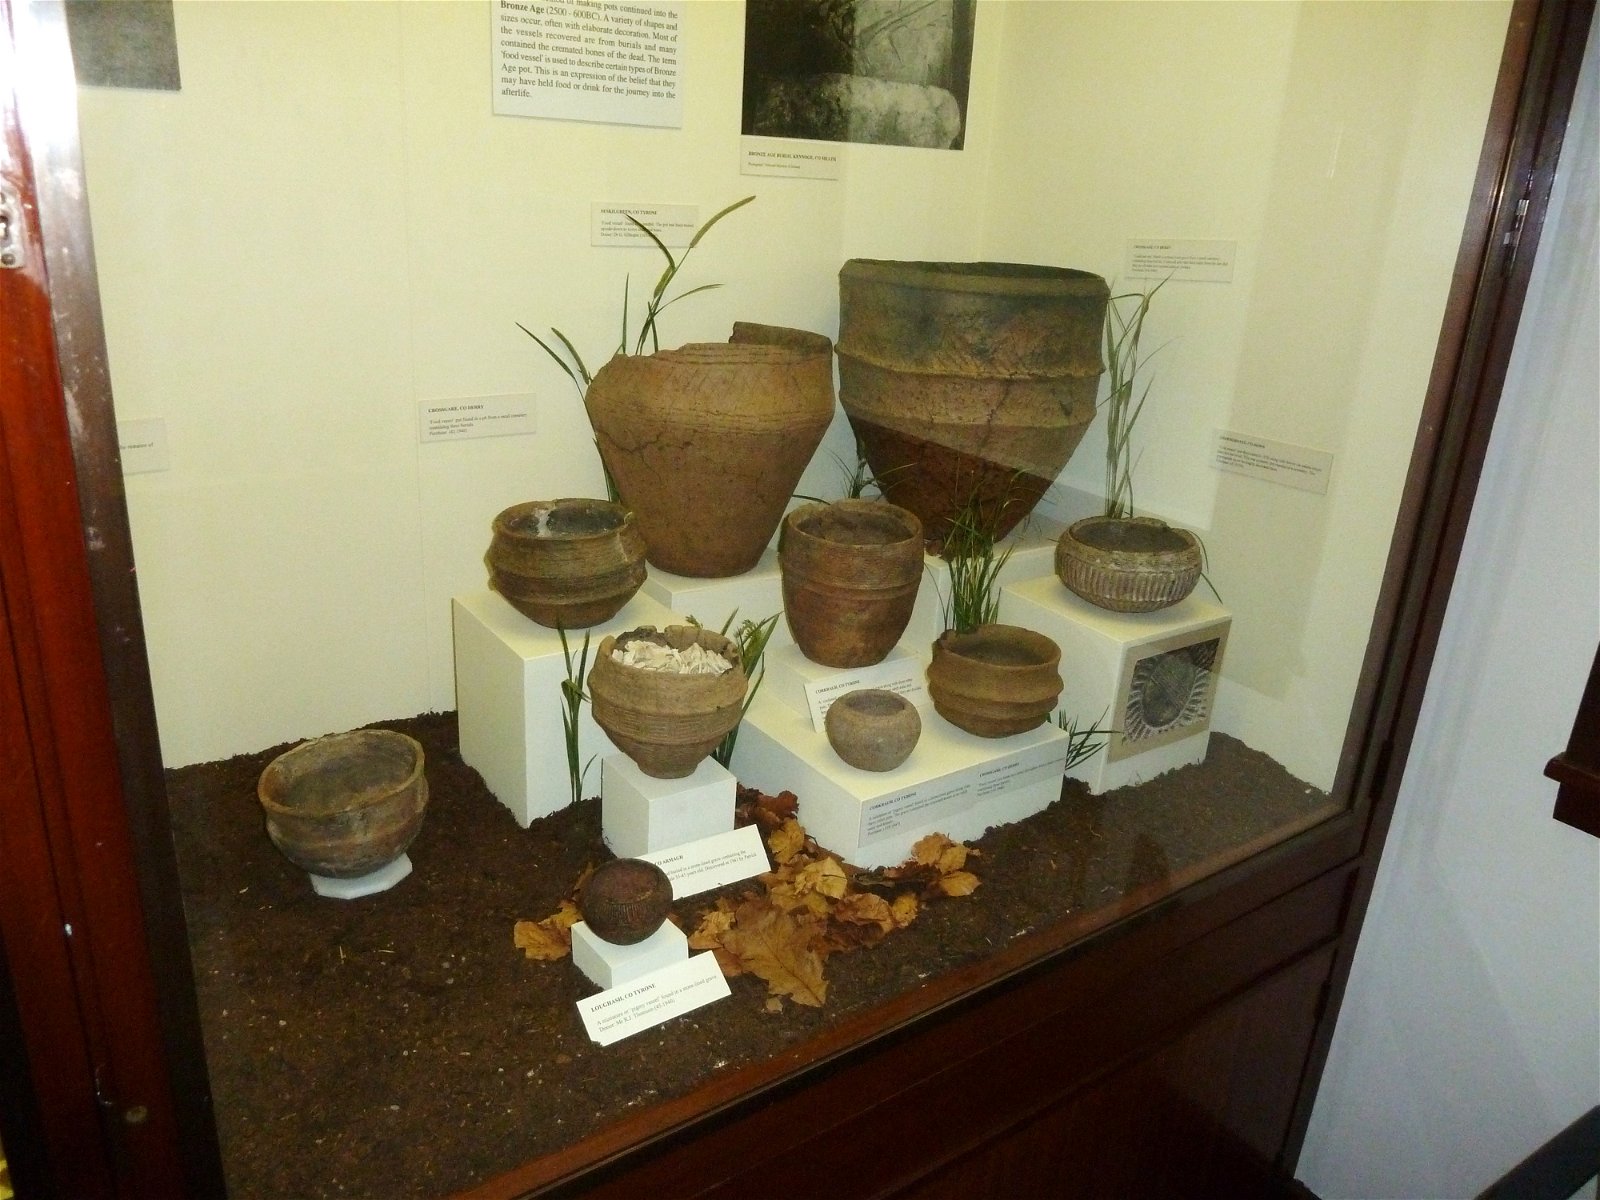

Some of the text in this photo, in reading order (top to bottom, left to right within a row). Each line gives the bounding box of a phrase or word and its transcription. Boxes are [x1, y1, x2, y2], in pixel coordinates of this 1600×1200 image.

[500, 0, 528, 11] Bronze
[530, 4, 545, 14] Age
[546, 6, 567, 16] (2500
[604, 14, 609, 22] A
[611, 16, 633, 26] variety
[644, 20, 665, 30] shapes
[666, 23, 678, 31] and
[577, 0, 602, 11] making
[620, 6, 652, 16] continued
[654, 8, 666, 17] into
[668, 10, 678, 19] the
[500, 14, 518, 23] sizes
[521, 18, 543, 26] occur,
[544, 20, 563, 28] often
[565, 22, 580, 30] with
[582, 23, 612, 34] elaborate
[614, 27, 651, 39] decoration.
[653, 32, 669, 41] Most
[500, 26, 513, 35] the
[516, 29, 543, 38] vessels
[546, 32, 581, 43] recovered
[598, 38, 616, 47] from
[619, 40, 642, 50] burials
[659, 46, 677, 55] many
[500, 40, 536, 50] contained
[538, 43, 550, 51] the
[552, 45, 584, 55] cremated
[586, 48, 605, 57] bones
[617, 52, 626, 60] the
[629, 53, 646, 61] dead.
[648, 55, 660, 64] The
[662, 57, 677, 65] term
[501, 51, 519, 60] 'food
[521, 54, 544, 63] vessel'
[545, 55, 551, 63] is
[552, 57, 568, 65] used
[577, 59, 605, 69] describe
[606, 62, 627, 71] certain
[629, 65, 645, 74] types
[655, 67, 677, 76] Bronze
[502, 63, 517, 73] Age
[519, 66, 532, 75] pot.
[534, 66, 550, 75] This
[570, 72, 606, 81] expression
[608, 74, 615, 82] of
[617, 75, 628, 83] the
[629, 76, 647, 85] belief
[649, 78, 661, 86] that
[662, 80, 676, 89] they
[502, 77, 517, 86] may
[520, 77, 536, 86] have
[538, 79, 554, 88] held
[556, 81, 571, 89] food
[583, 83, 600, 92] drink
[602, 85, 612, 93] for
[614, 86, 624, 94] the
[626, 88, 650, 98] journey
[666, 91, 676, 99] the
[502, 88, 532, 98] afterlife.
[663, 855, 684, 864] ARMAGH
[633, 983, 656, 996] TYRONE
